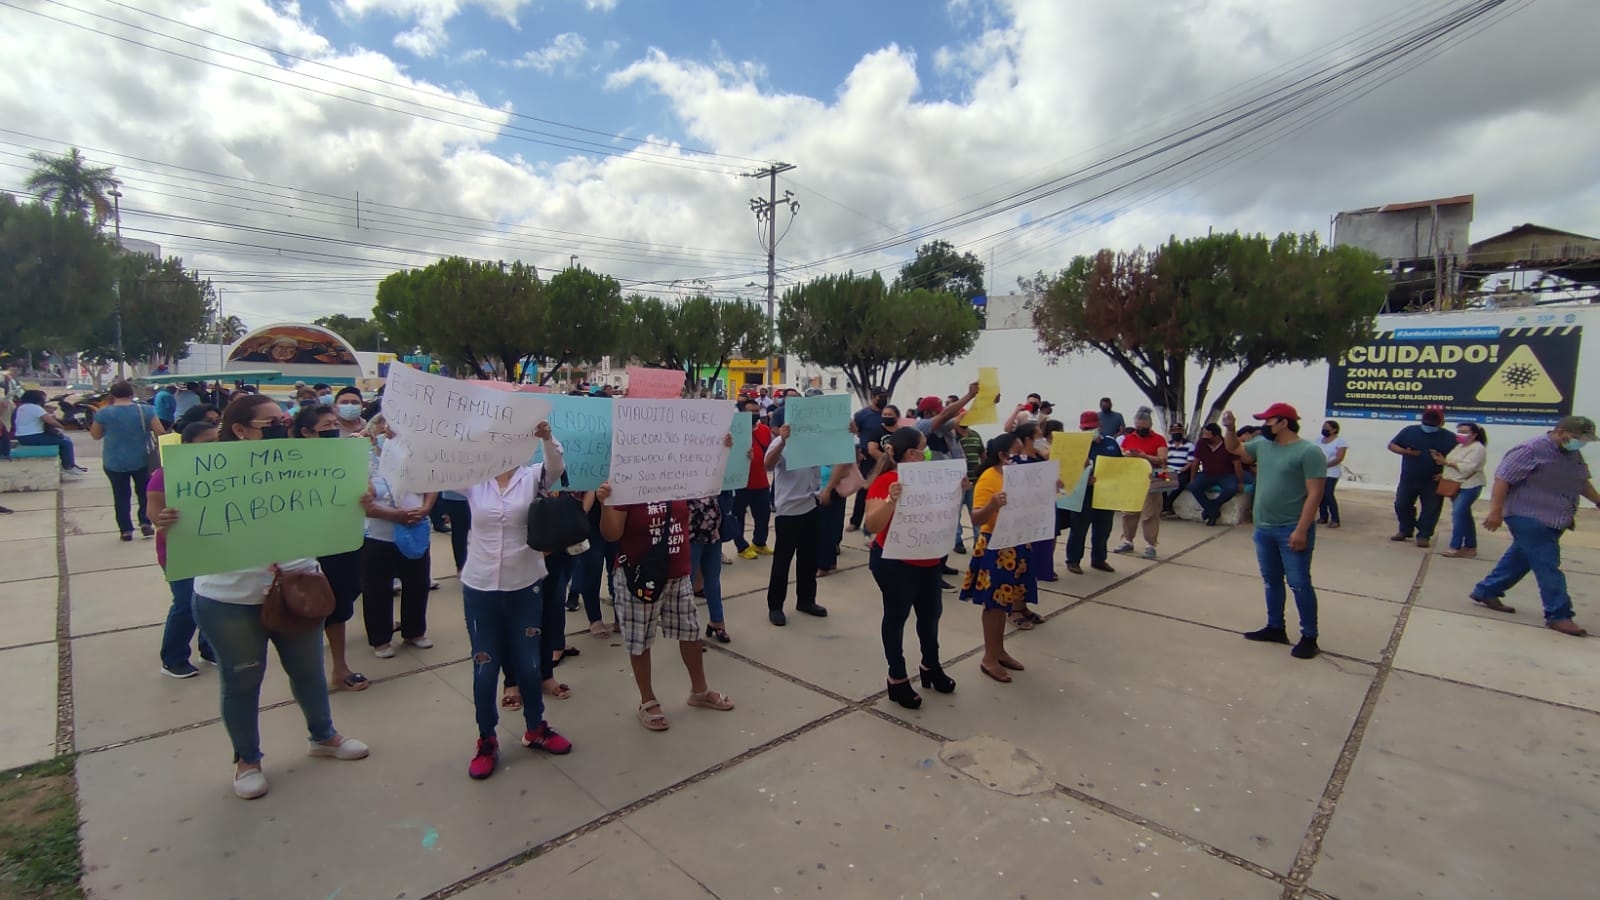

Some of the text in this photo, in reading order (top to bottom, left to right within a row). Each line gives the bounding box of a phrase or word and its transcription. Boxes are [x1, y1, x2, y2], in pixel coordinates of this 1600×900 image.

[1338, 344, 1500, 366] ¡CUIDADO!
[1347, 368, 1457, 378] ZONA DE ALTO
[1345, 392, 1454, 401] CUBREBOCAS OBLIGATORIO
[1346, 380, 1423, 391] CONTAGIO
[447, 390, 513, 425] FAMILIA
[617, 404, 719, 426] MALDITO AQUEL
[386, 399, 480, 443] SINDICAL
[195, 449, 303, 475] NO MAS
[176, 468, 346, 498] HOSTIGAMIENTO
[638, 470, 656, 482] SUS
[197, 485, 347, 536] LABORAL
